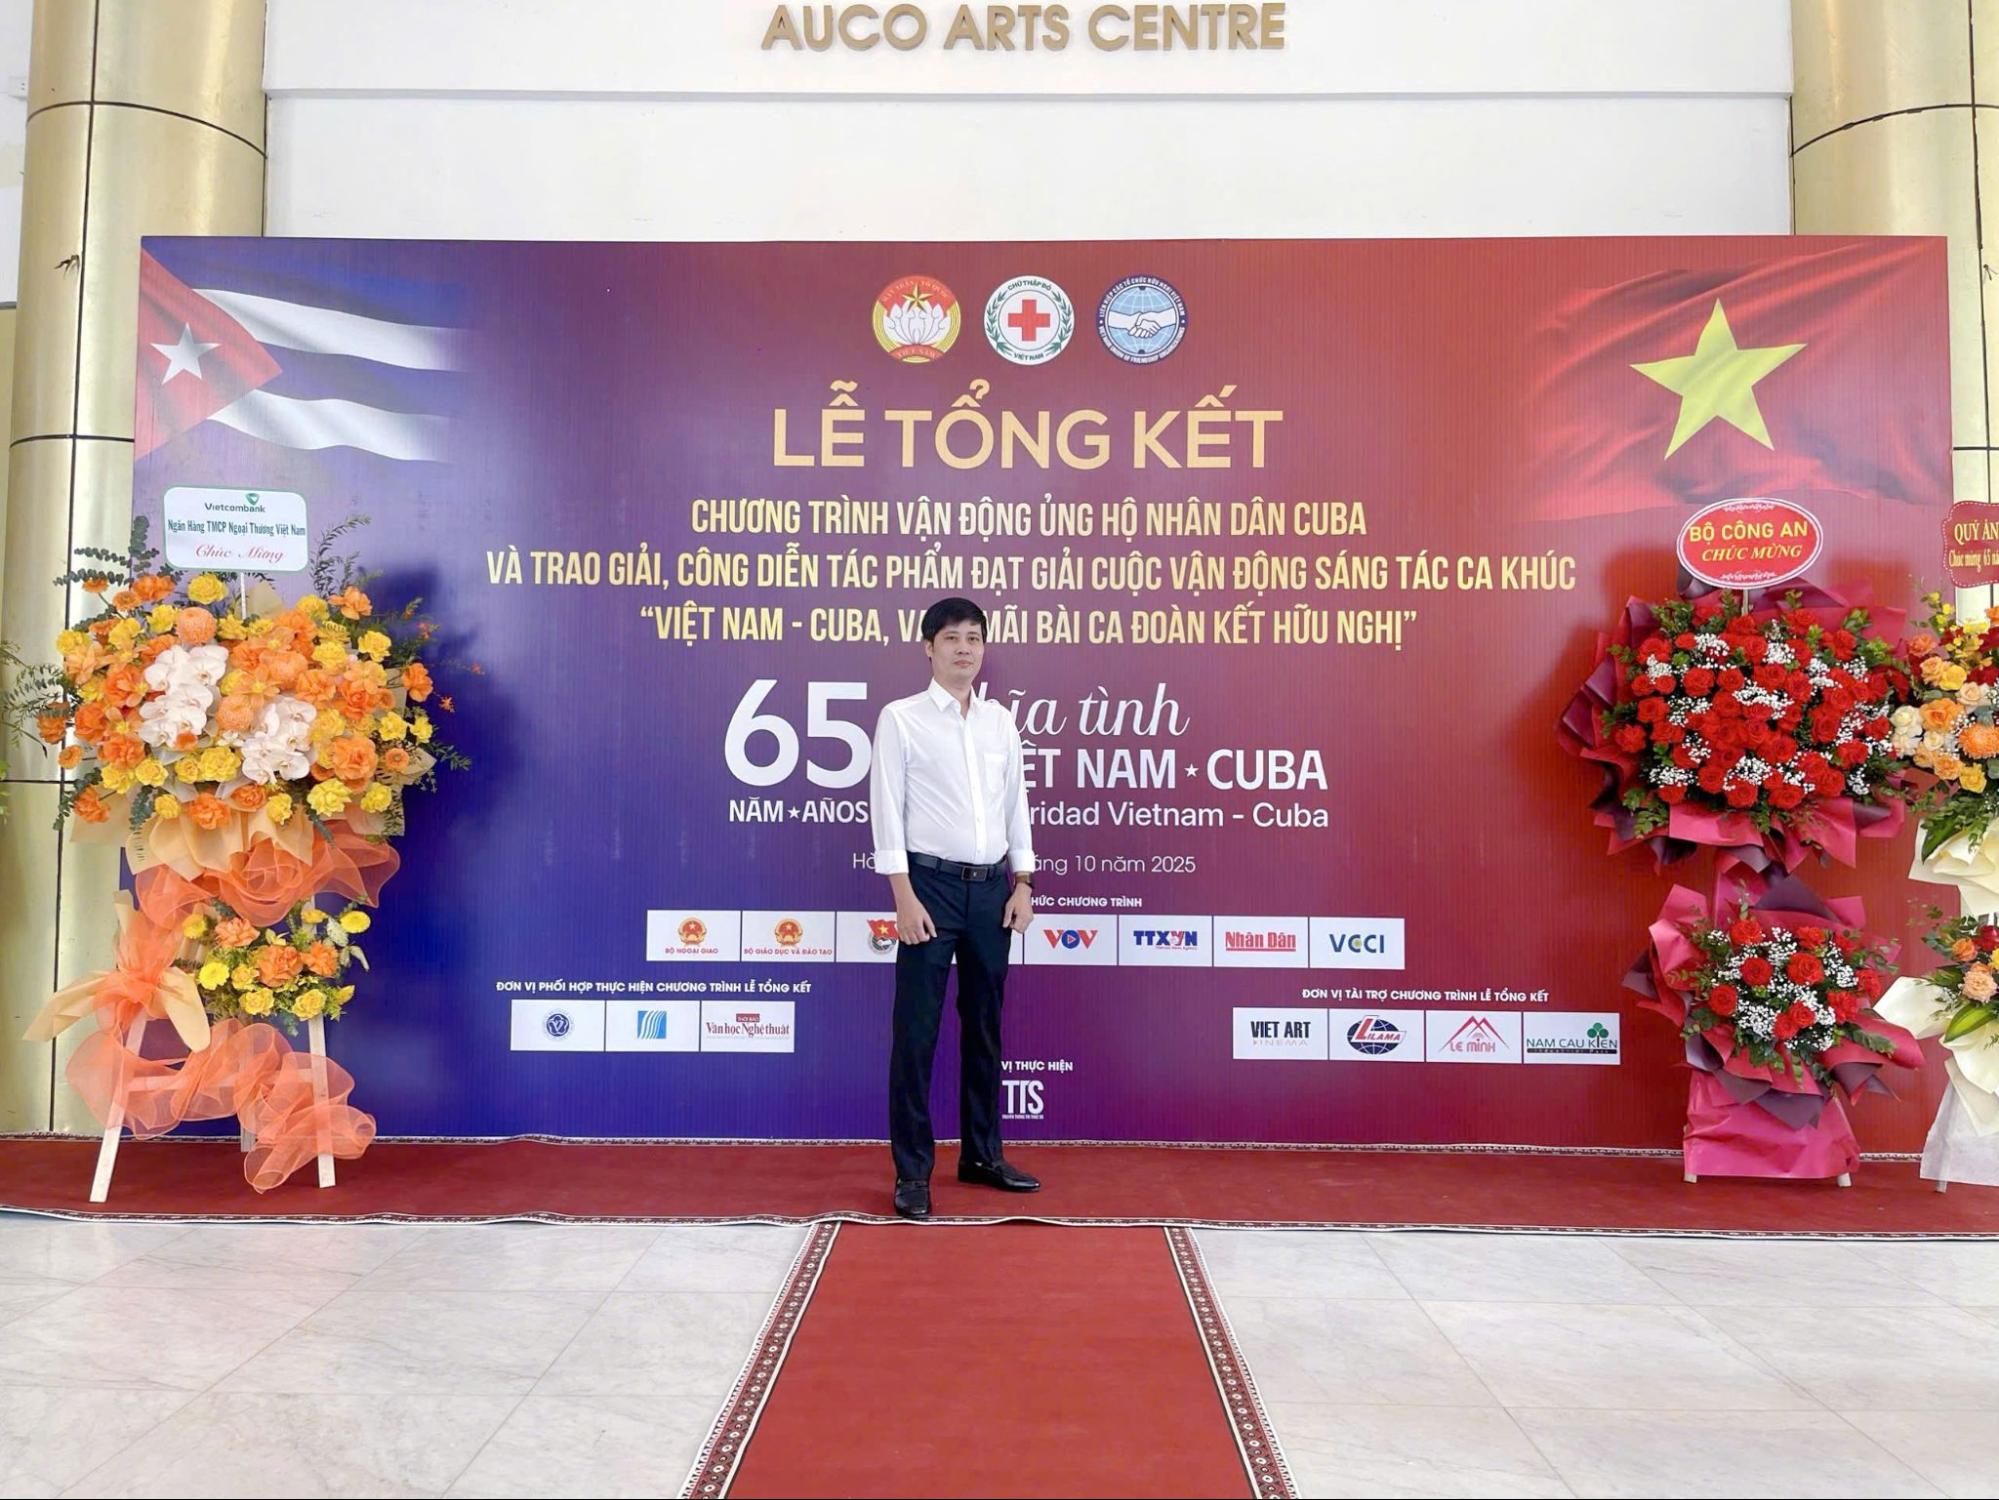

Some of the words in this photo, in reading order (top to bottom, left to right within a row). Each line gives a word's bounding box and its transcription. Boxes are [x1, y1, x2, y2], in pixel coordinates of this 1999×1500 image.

[761, 3, 927, 51] AUCO
[943, 3, 1070, 51] ARTS
[1088, 2, 1286, 51] CENTRE
[774, 380, 865, 467] LỄ
[885, 378, 1111, 469] TỔNG
[1133, 384, 1283, 469] KẾT
[205, 502, 266, 513] Vietcombank
[692, 499, 800, 535] CHƯƠNG
[809, 495, 889, 535] TRÌNH
[897, 496, 950, 542] VẬN
[959, 496, 1031, 542] ĐỘNG
[1039, 492, 1093, 536] ỦNG
[1101, 496, 1137, 543] HỘ
[1146, 496, 1220, 536] NHÂN
[1230, 496, 1285, 536] DÂN
[1294, 501, 1367, 537] CUBA
[207, 521, 227, 532] TMCP
[229, 522, 248, 536] Ngoại
[291, 525, 306, 536] Nam
[1690, 521, 1715, 545] BỘ
[1722, 519, 1774, 540] CÔNG
[1780, 520, 1808, 537] AN
[1702, 545, 1748, 561] CHÚC
[1751, 543, 1802, 559] MỪNG
[487, 545, 523, 584] VÀ
[530, 551, 600, 585] TRAO
[608, 543, 670, 592] GIẢI,
[677, 546, 749, 587] CÔNG
[757, 542, 819, 587] DIỄN
[826, 550, 878, 588] TÁC
[886, 542, 963, 590] PHẨM
[971, 554, 1024, 597] ĐẠT
[1032, 546, 1083, 590] GIẢI
[1091, 551, 1161, 597] CUỘC
[1169, 550, 1224, 597] VẬN
[1233, 550, 1306, 597] ĐỘNG
[1315, 550, 1387, 590] SÁNG
[1396, 550, 1448, 590] TÁC
[1456, 556, 1493, 590] CA
[1501, 550, 1576, 590] KHÚC
[641, 601, 714, 646] “VIỆT
[722, 607, 783, 640] NAM
[810, 608, 888, 646] CUBA,
[982, 604, 1028, 643] MÃI
[1037, 603, 1080, 643] BÀI
[1088, 610, 1124, 643] CA
[1131, 603, 1205, 643] ĐOÀN
[1213, 600, 1265, 643] KẾT
[1273, 603, 1329, 644] HỮU
[1337, 610, 1417, 650] NGHỊ”
[1078, 682, 1190, 736] tình
[725, 679, 872, 789] 65
[1022, 739, 1061, 793] ỆT
[1077, 749, 1176, 789] NAM
[1207, 749, 1328, 790] CUBA
[729, 796, 783, 822] NĂM
[802, 797, 868, 823] AÑOS
[1030, 801, 1099, 826] ridad
[1107, 801, 1224, 827] Vietnam
[1252, 802, 1328, 827] Cuba
[1034, 854, 1067, 876] áng
[1077, 856, 1096, 873] 10
[1102, 856, 1145, 873] năm
[1151, 856, 1196, 873] 2025
[1031, 895, 1055, 907] HỨC
[1058, 896, 1108, 907] CHƯƠNG
[1110, 896, 1142, 907] TRÌNH
[1043, 928, 1098, 949] VOV
[1225, 931, 1263, 948] Nhân
[1267, 931, 1296, 948] Dân
[1330, 933, 1384, 953] VCCI
[496, 981, 521, 992] ĐƠN
[524, 982, 536, 994] VỊ
[539, 979, 566, 992] PHỐI
[569, 981, 593, 994] HỢP
[595, 982, 625, 994] THỰC
[628, 981, 653, 994] HIỆN
[656, 982, 707, 992] CHƯƠNG
[710, 981, 741, 992] TRÌNH
[744, 979, 756, 992] LỄ
[758, 979, 790, 993] TỔNG
[793, 980, 811, 993] KẾT
[1302, 988, 1327, 998] ĐƠN
[1331, 990, 1342, 1001] VỊ
[1345, 988, 1362, 999] TÀI
[1365, 989, 1387, 1002] TRỢ
[1391, 990, 1441, 1000] CHƯƠNG
[1444, 989, 1477, 1000] TRÌNH
[1481, 988, 1491, 1001] LỄ
[1494, 988, 1527, 1002] TỔNG
[1530, 989, 1549, 1002] KẾT
[1251, 1021, 1280, 1038] VIET
[1284, 1021, 1311, 1038] ART
[1526, 1039, 1555, 1047] NAM
[1559, 1039, 1584, 1048] CAU
[1001, 1061, 1012, 1073] VỊ
[1015, 1060, 1045, 1073] THỰC
[1048, 1059, 1073, 1074] HIỆN
